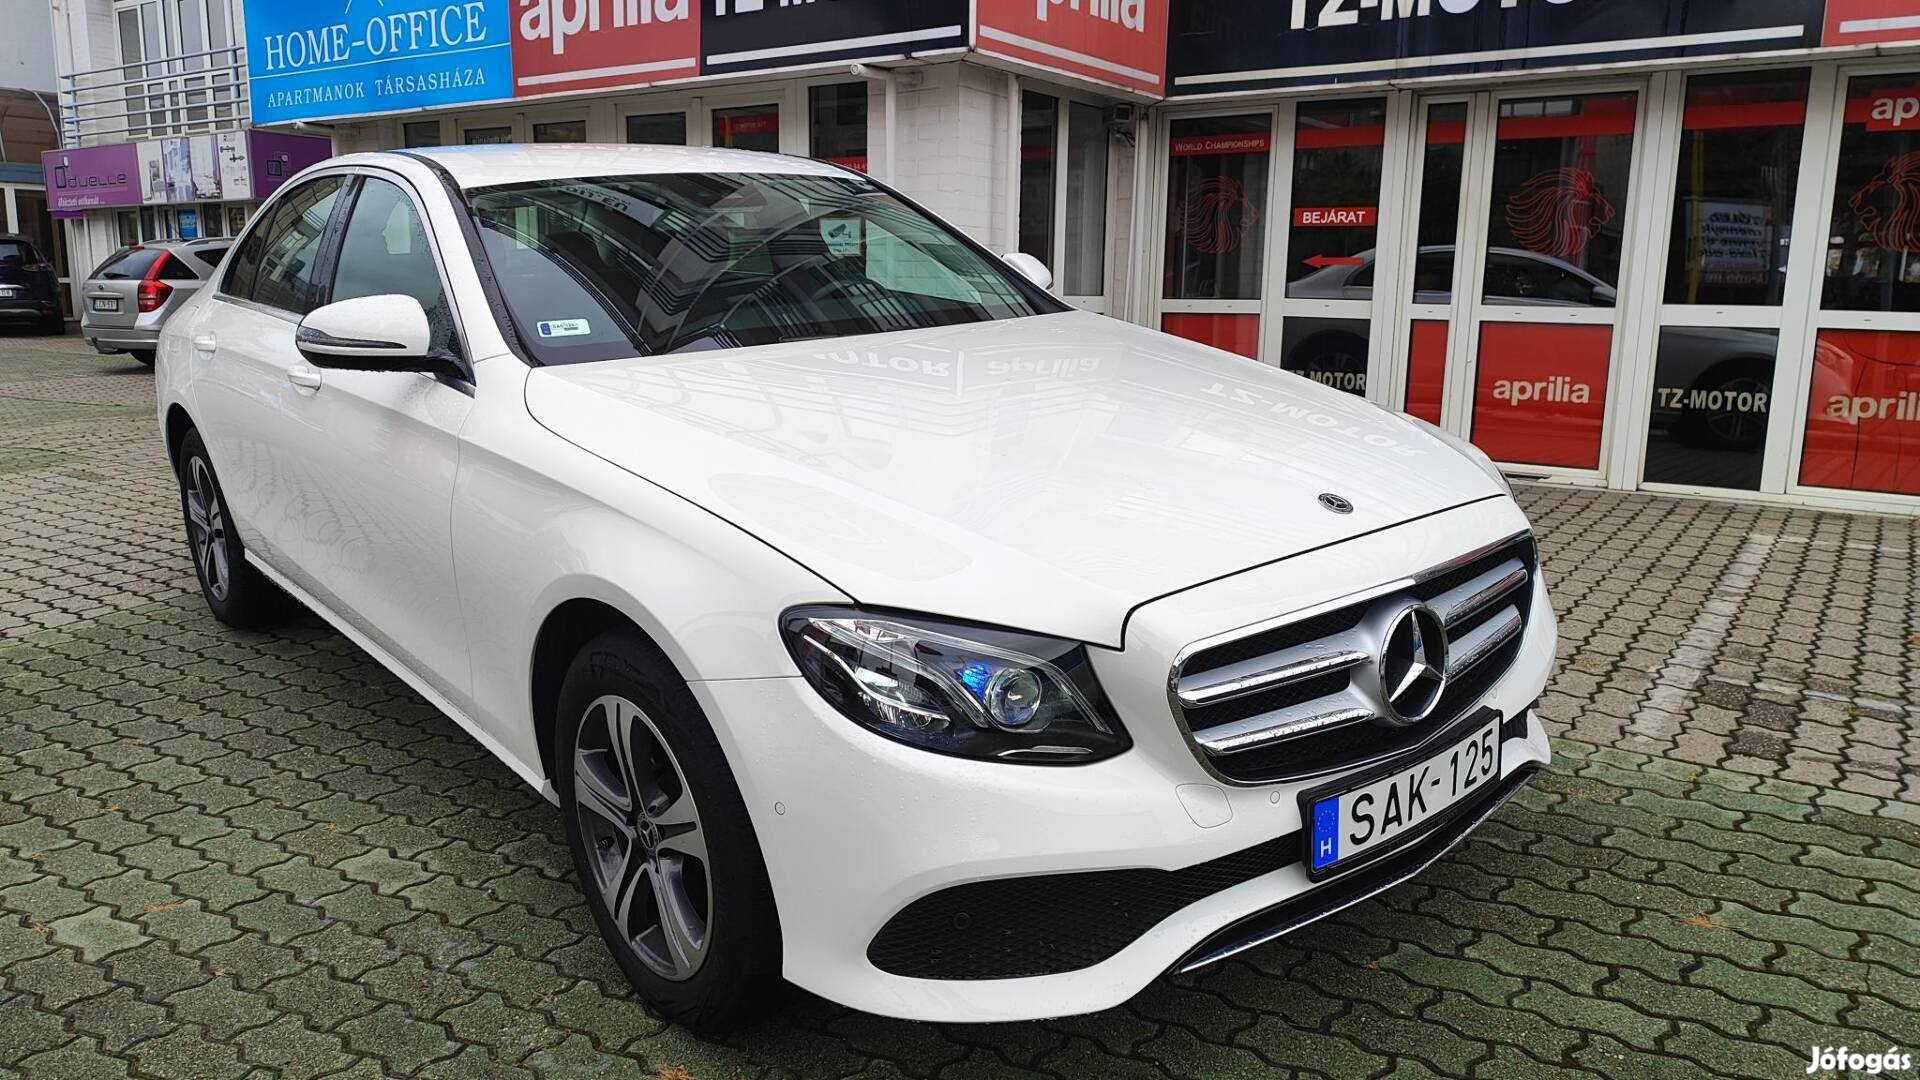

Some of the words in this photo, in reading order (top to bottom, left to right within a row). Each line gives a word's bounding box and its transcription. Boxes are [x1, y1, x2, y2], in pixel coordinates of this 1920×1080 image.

[263, 1, 487, 70] HOME-OFFICE
[267, 81, 365, 107] APARTMANOK
[374, 67, 486, 97] TÁRSASHÁZA
[1175, 142, 1203, 152] WORLD
[1205, 139, 1265, 150] CHAMPIONSHIPS
[1302, 209, 1366, 224] BEJÁRAT
[1492, 376, 1590, 406] aprilia
[1658, 387, 1768, 413] TZ-MOTOR
[1349, 728, 1494, 846] SAK-125
[1320, 837, 1332, 858] H
